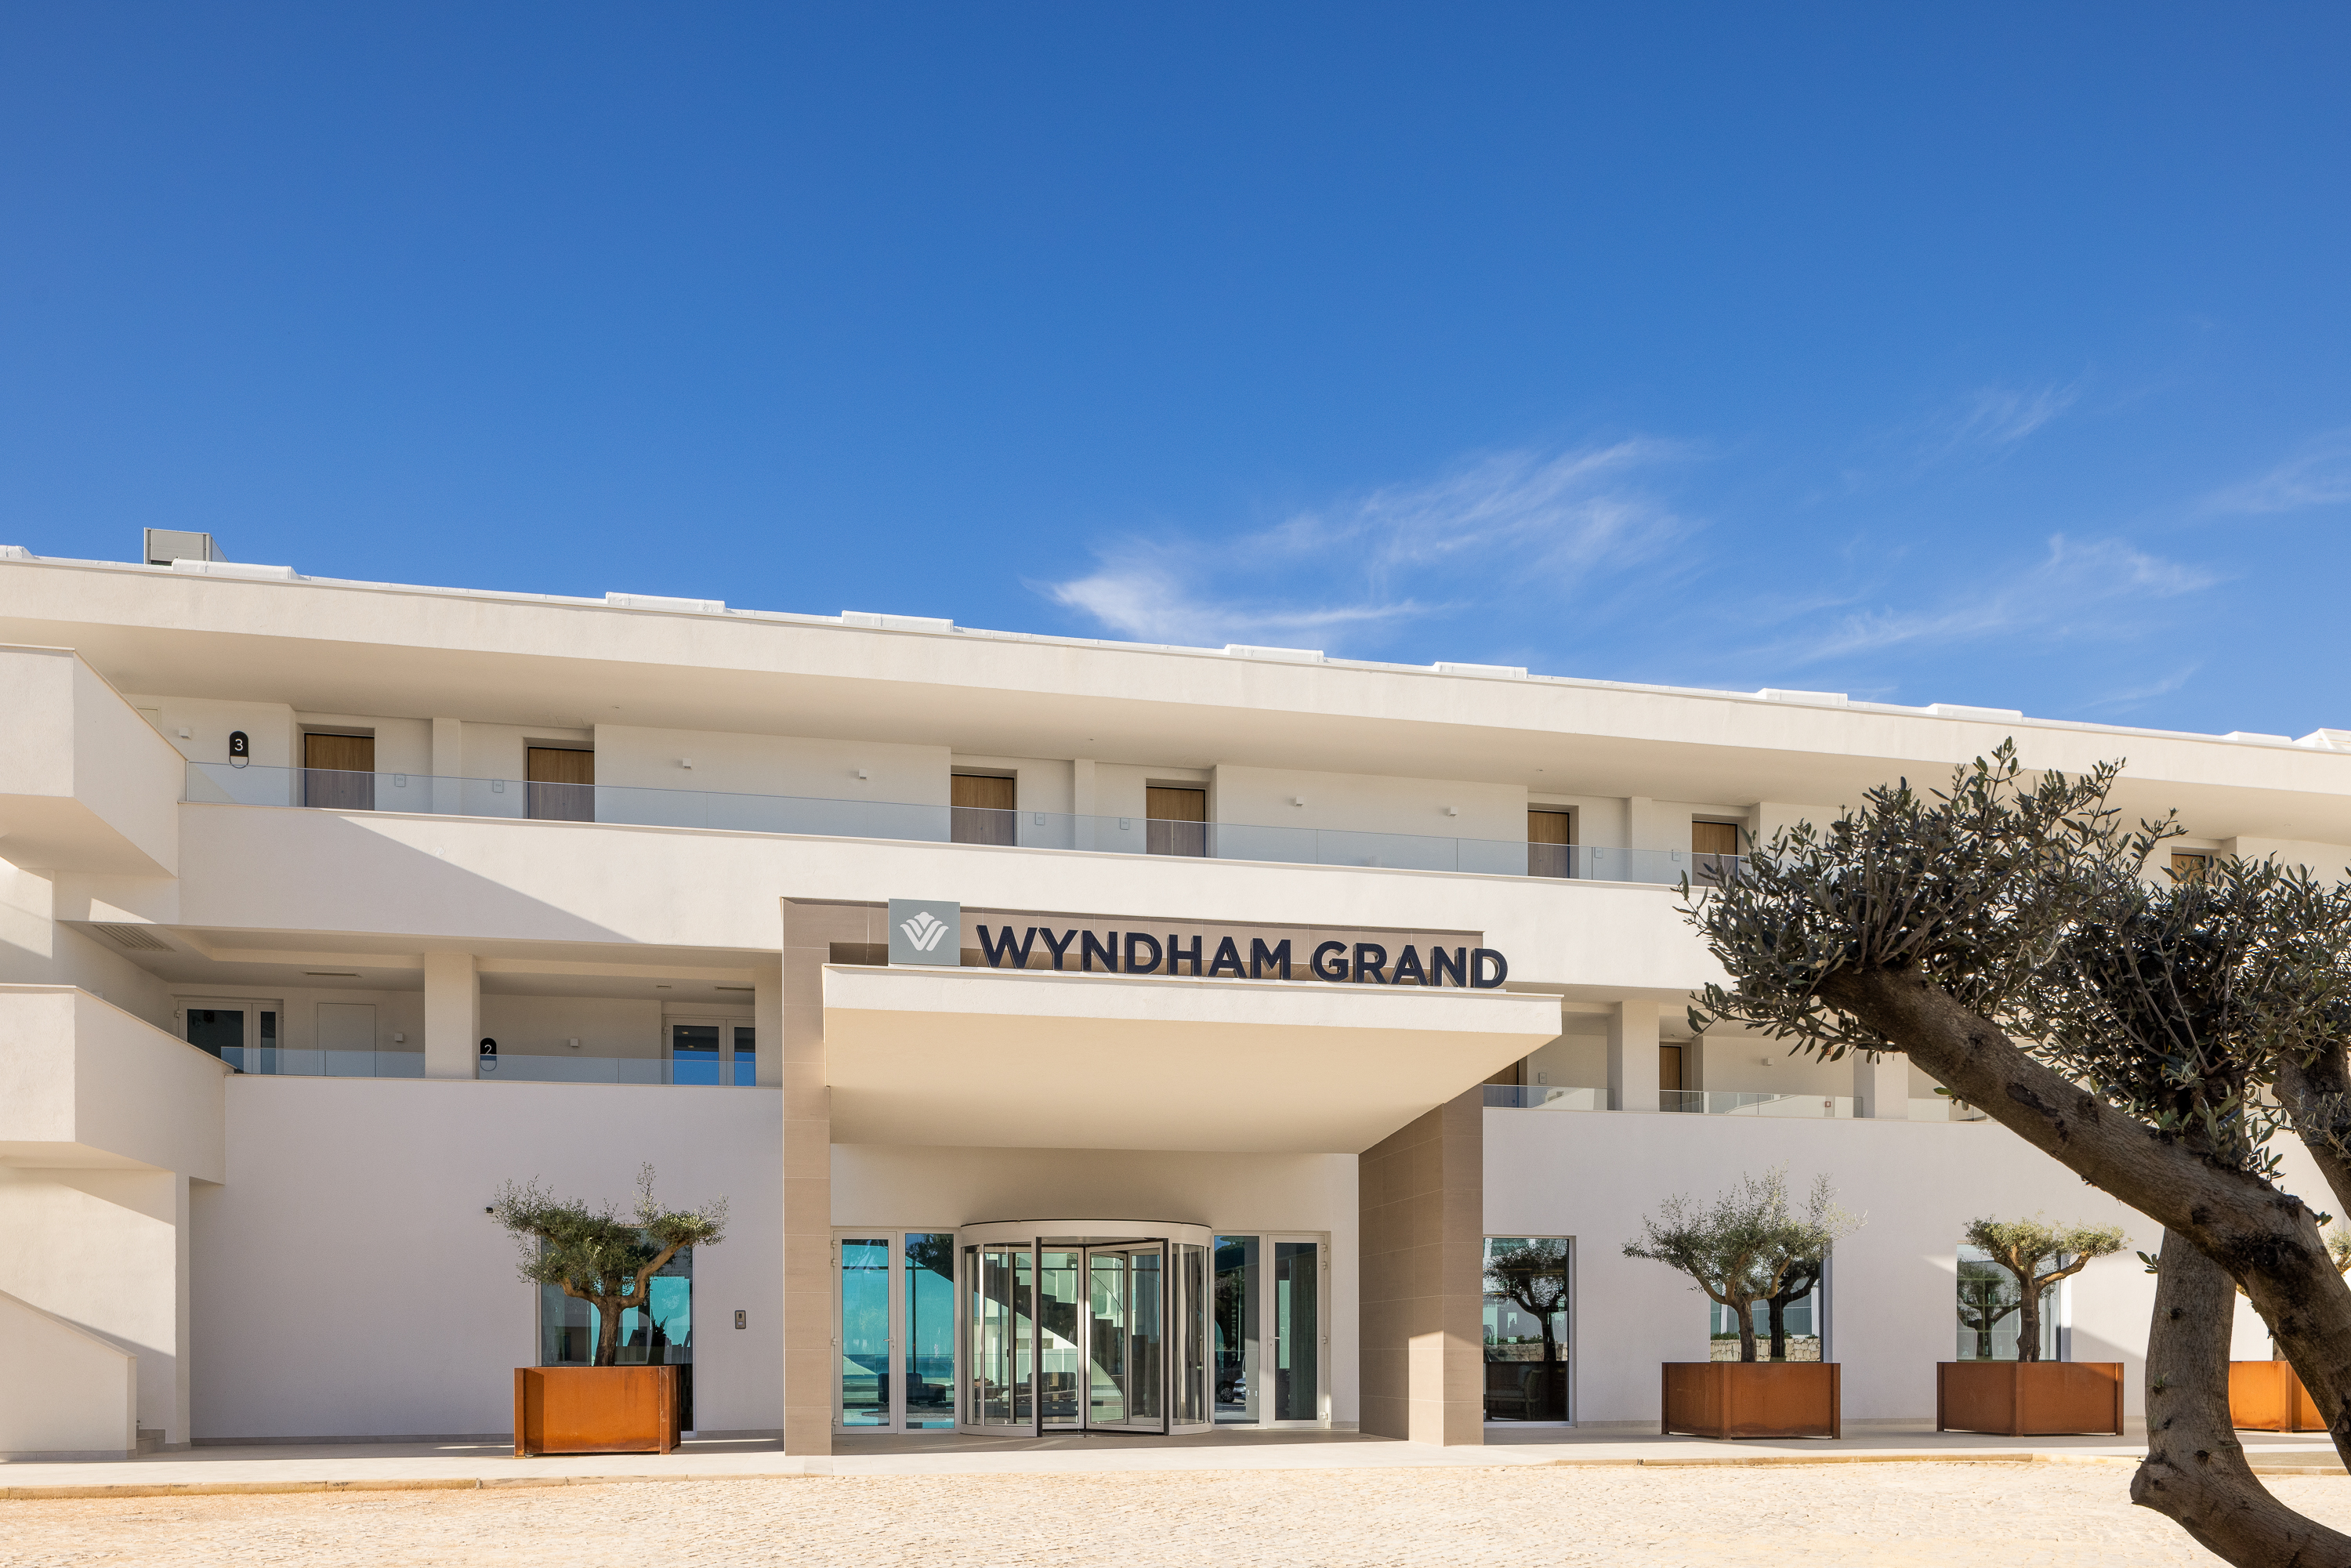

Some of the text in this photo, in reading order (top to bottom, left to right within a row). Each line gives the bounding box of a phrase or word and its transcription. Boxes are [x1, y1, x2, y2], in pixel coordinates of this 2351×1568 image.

[234, 738, 244, 751] 3
[976, 924, 1509, 989] WYNDHAM GRAND
[484, 1044, 492, 1056] 2
